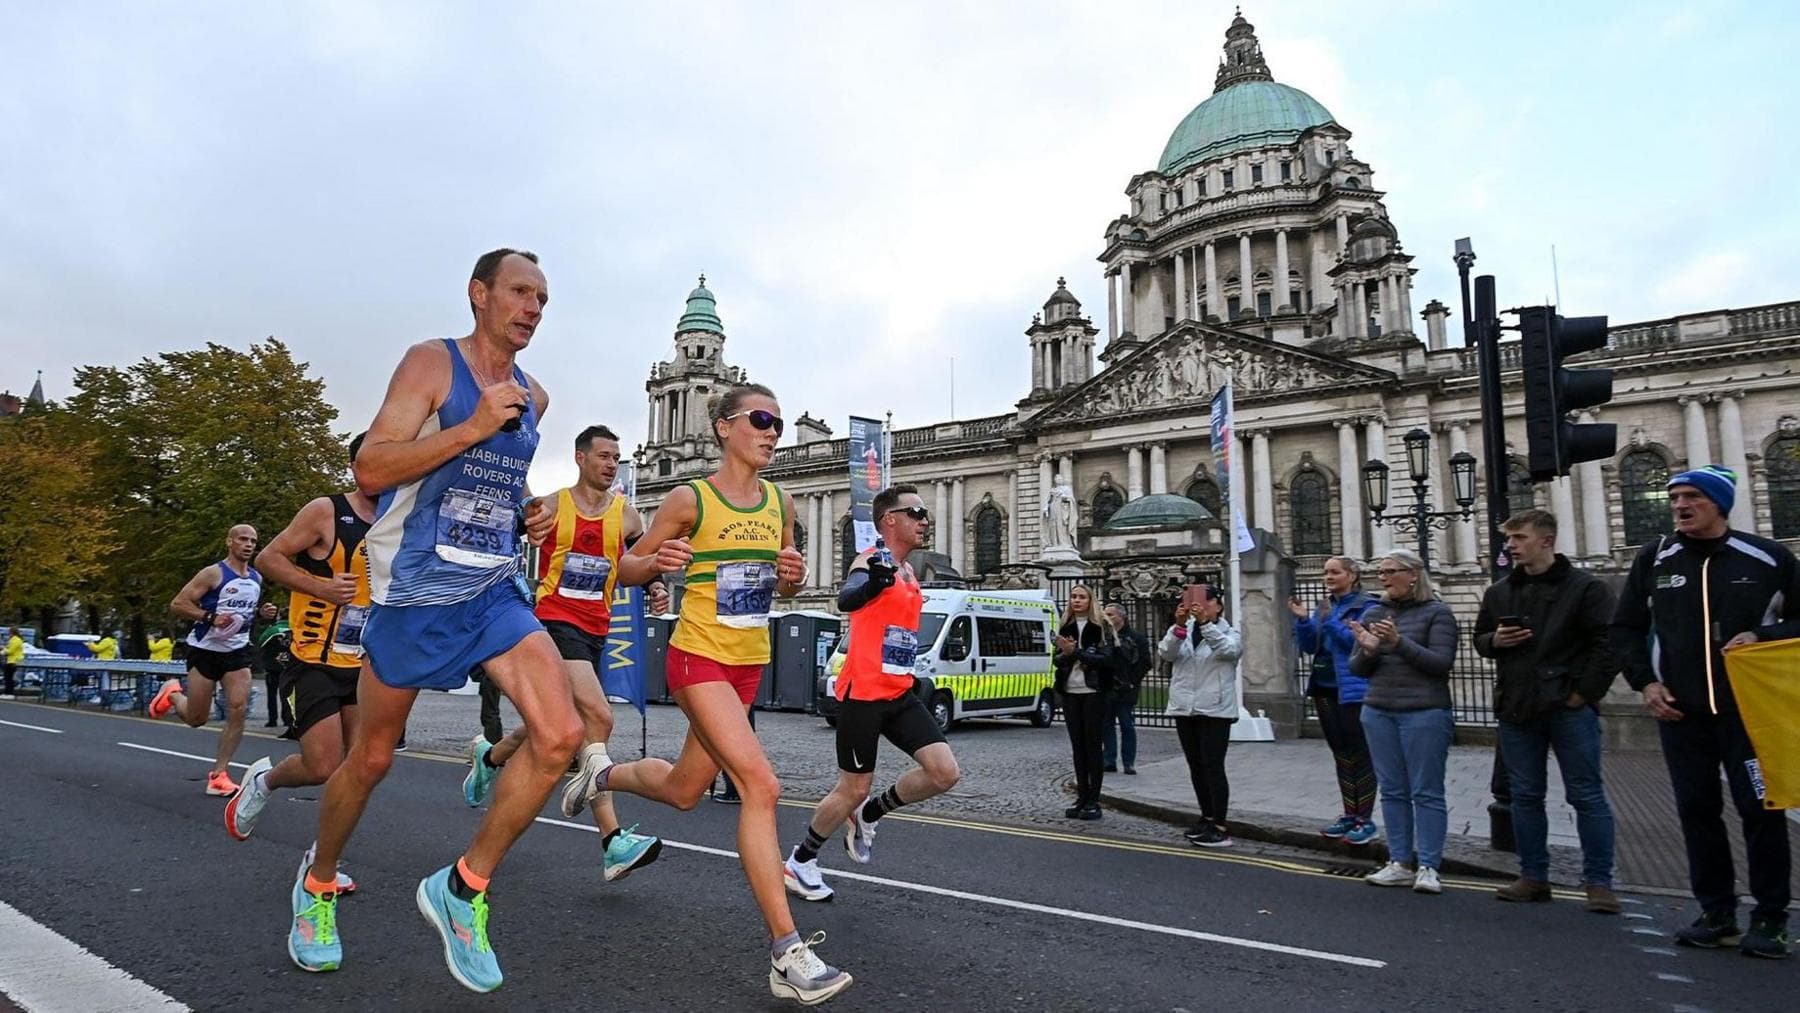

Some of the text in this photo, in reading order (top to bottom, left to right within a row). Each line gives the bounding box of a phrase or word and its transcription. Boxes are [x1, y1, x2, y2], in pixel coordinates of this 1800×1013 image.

[463, 448, 500, 465] LIABH
[463, 463, 525, 488] ROVERS AC
[474, 484, 512, 501] FERNS
[448, 523, 503, 550] 4239
